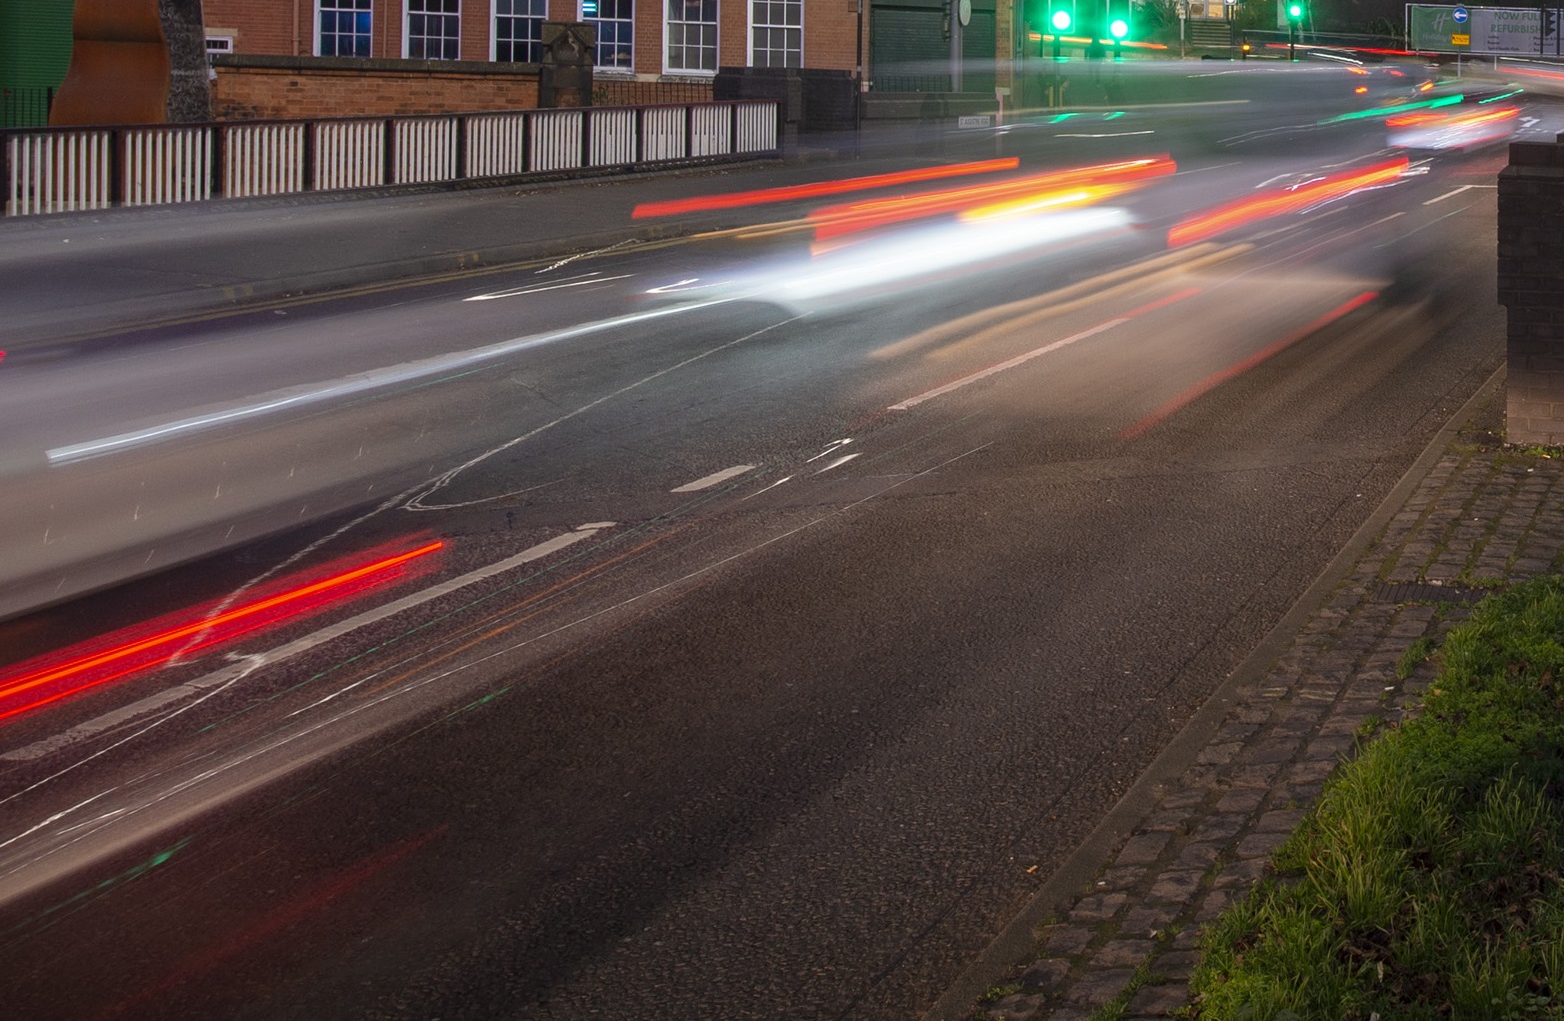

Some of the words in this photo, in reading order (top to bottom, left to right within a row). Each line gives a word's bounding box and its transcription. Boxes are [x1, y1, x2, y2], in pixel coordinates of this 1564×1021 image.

[1494, 11, 1519, 21] NOW
[1521, 12, 1542, 21] FUL
[1490, 23, 1541, 34] REFURBISH
